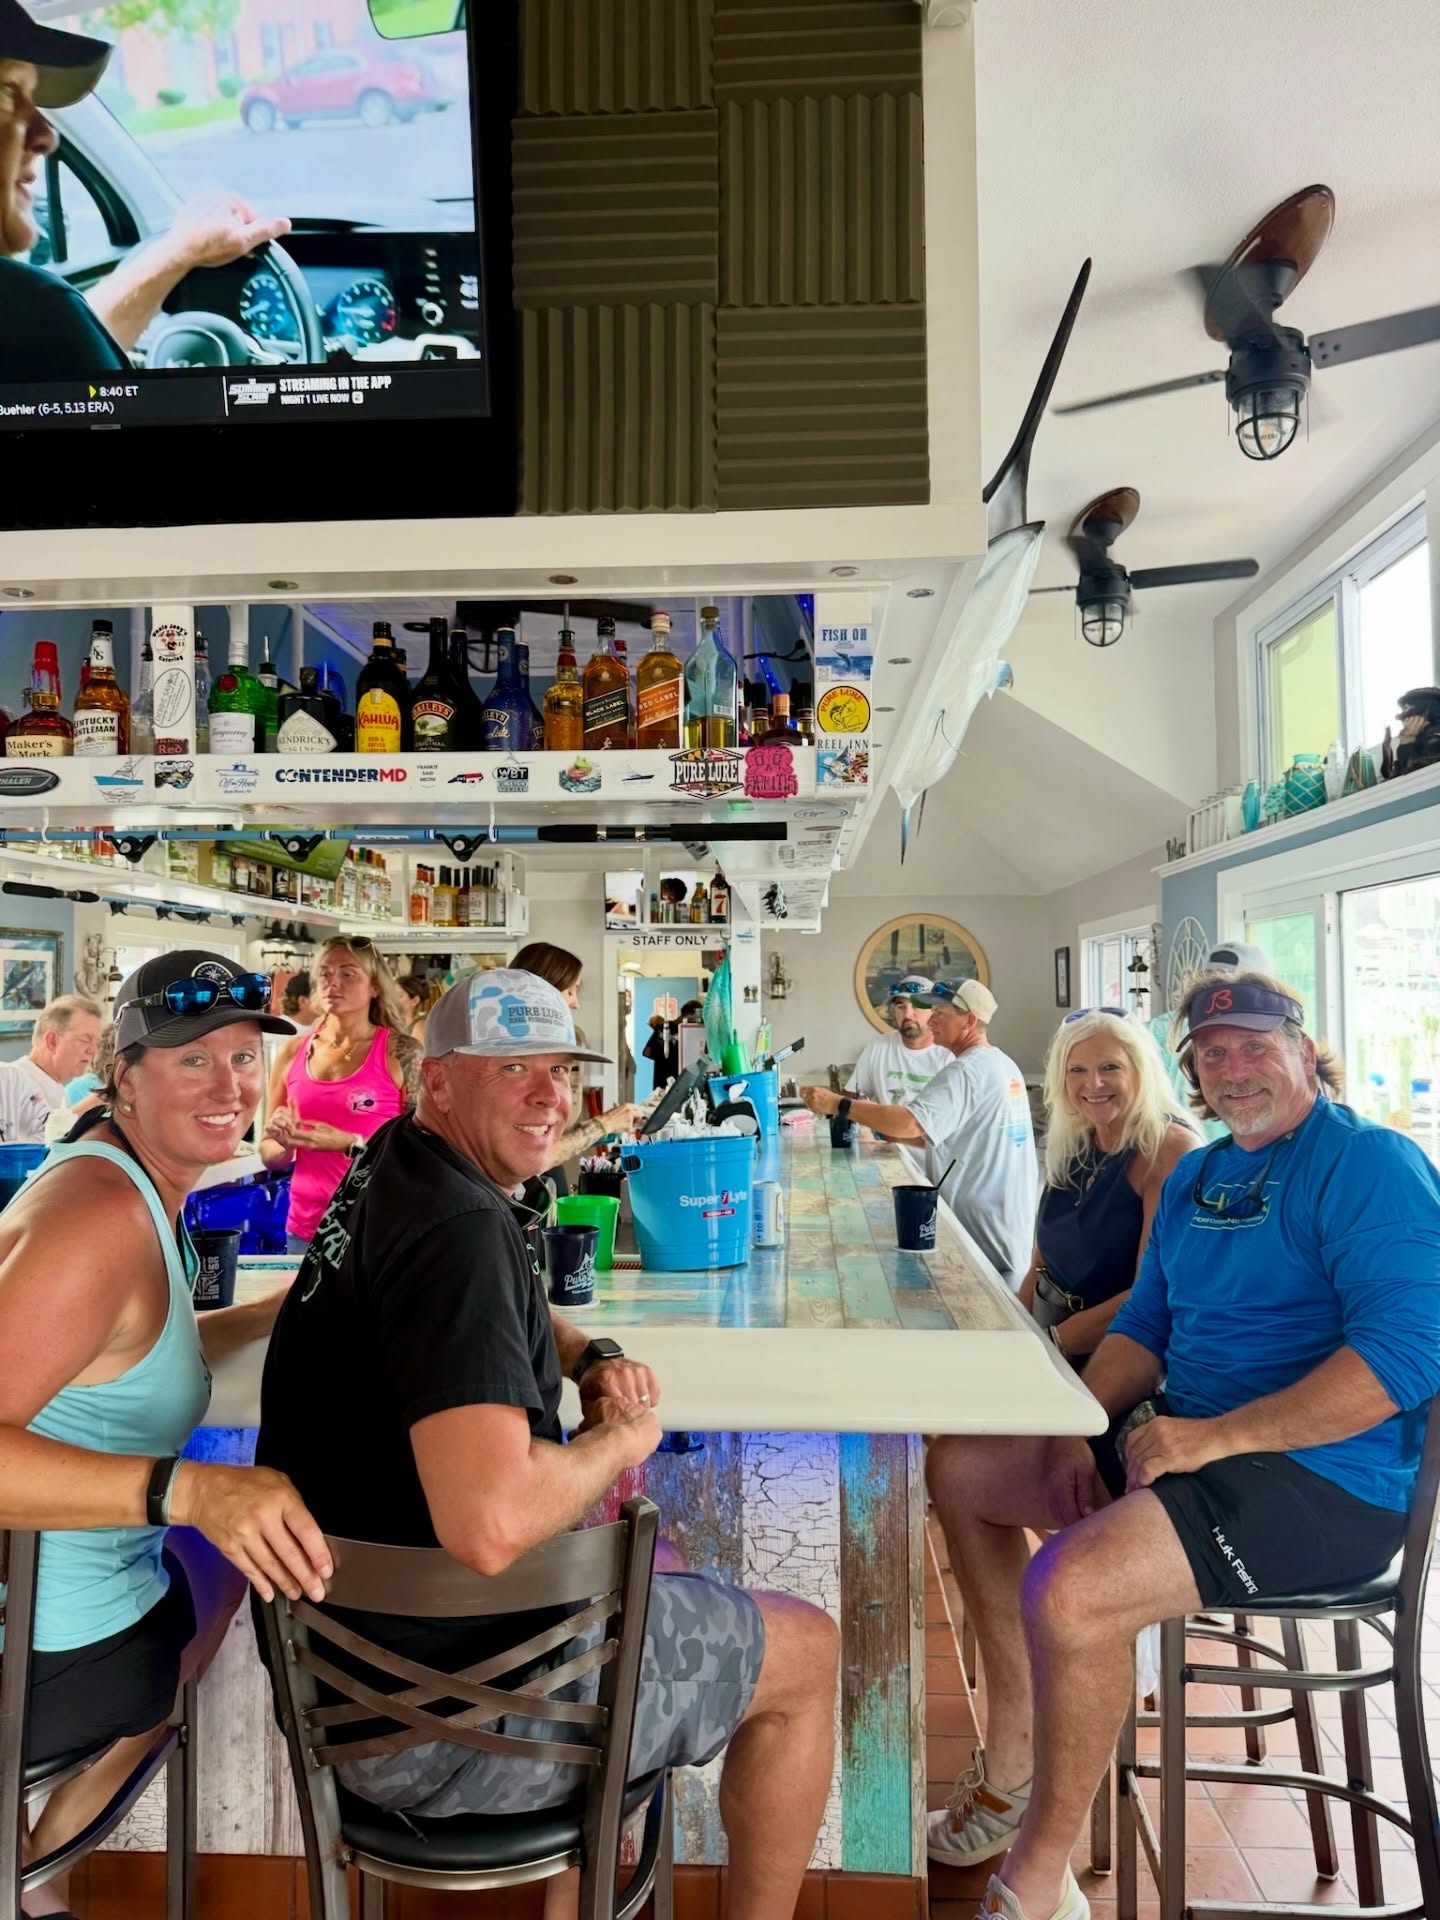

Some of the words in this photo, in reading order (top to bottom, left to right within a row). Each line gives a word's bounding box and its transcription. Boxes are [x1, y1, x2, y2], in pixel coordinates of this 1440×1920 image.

[280, 377, 337, 392] STREAMING
[338, 377, 349, 390] IN
[350, 376, 369, 390] THE
[371, 375, 392, 390] APP
[99, 386, 123, 397] 8:40
[125, 386, 139, 397] ET
[280, 394, 304, 405] NIGHT
[305, 394, 311, 404] 1
[312, 394, 329, 404] LIVE
[330, 393, 350, 403] NOW
[65, 402, 86, 413] 5.13
[88, 401, 115, 415] ERA)
[821, 628, 848, 642] FISH
[605, 699, 625, 709] LABEL
[638, 699, 654, 710] RED
[656, 691, 679, 704] LABEL
[820, 690, 839, 713] PURE
[839, 688, 865, 702] LURE
[359, 711, 399, 731] KAHLÚA
[7, 740, 53, 750] Maker's
[817, 738, 844, 750] REEL
[849, 738, 869, 750] INN
[498, 768, 528, 779] WBT
[676, 761, 706, 783] PURE
[707, 761, 738, 783] LURE
[714, 893, 727, 914] 7
[633, 935, 672, 946] STAFF
[675, 935, 708, 946] ONLY
[508, 1006, 540, 1017] PURE
[679, 1194, 720, 1209] Super
[1212, 1526, 1235, 1561] Huk
